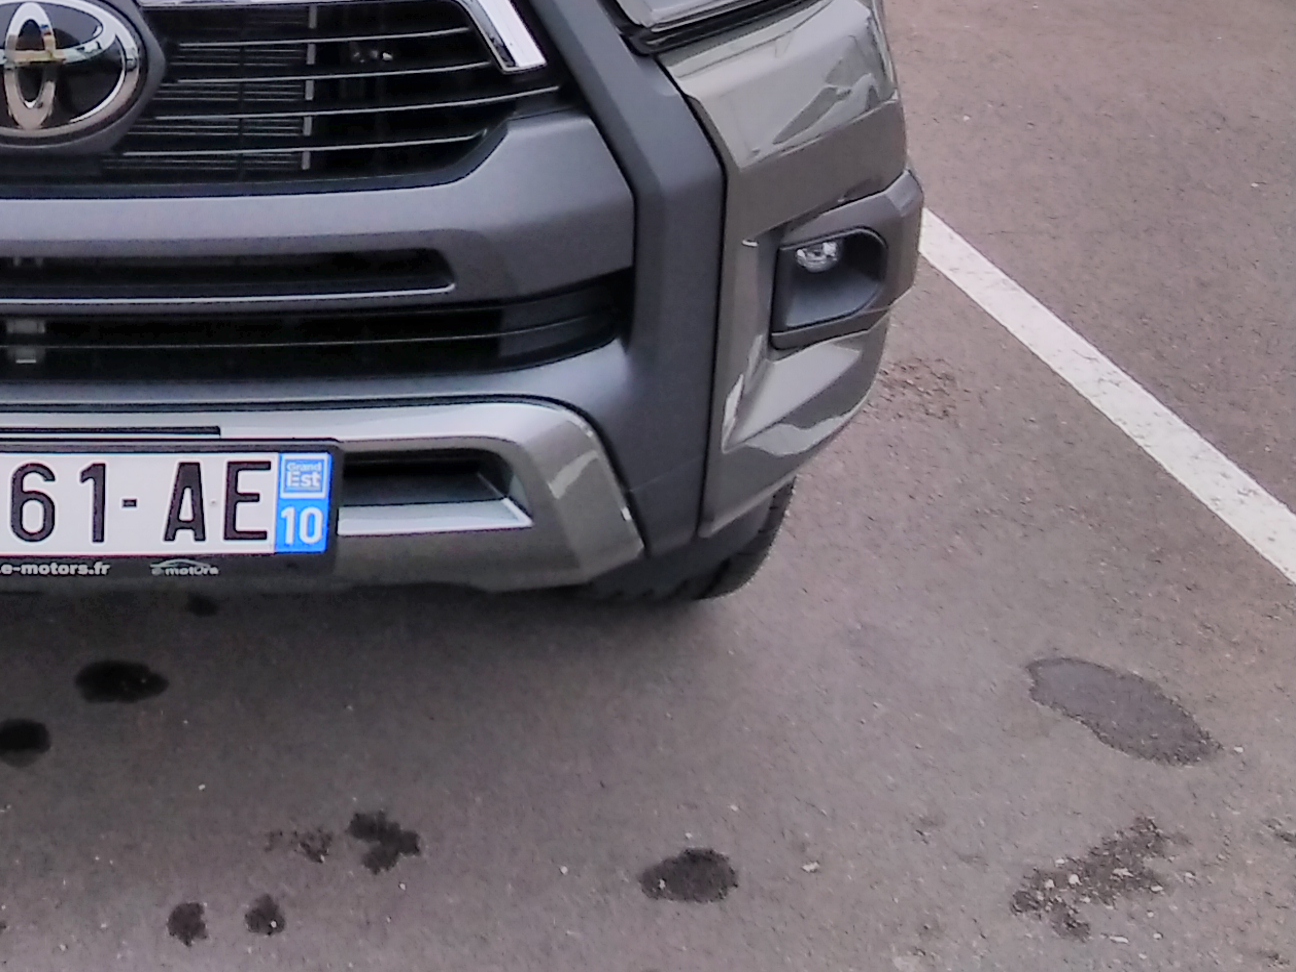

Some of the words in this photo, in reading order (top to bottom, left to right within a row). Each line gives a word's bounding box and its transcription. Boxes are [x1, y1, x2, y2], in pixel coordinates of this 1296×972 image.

[286, 461, 322, 473] Grand
[286, 471, 321, 487] Est
[281, 507, 323, 545] 10
